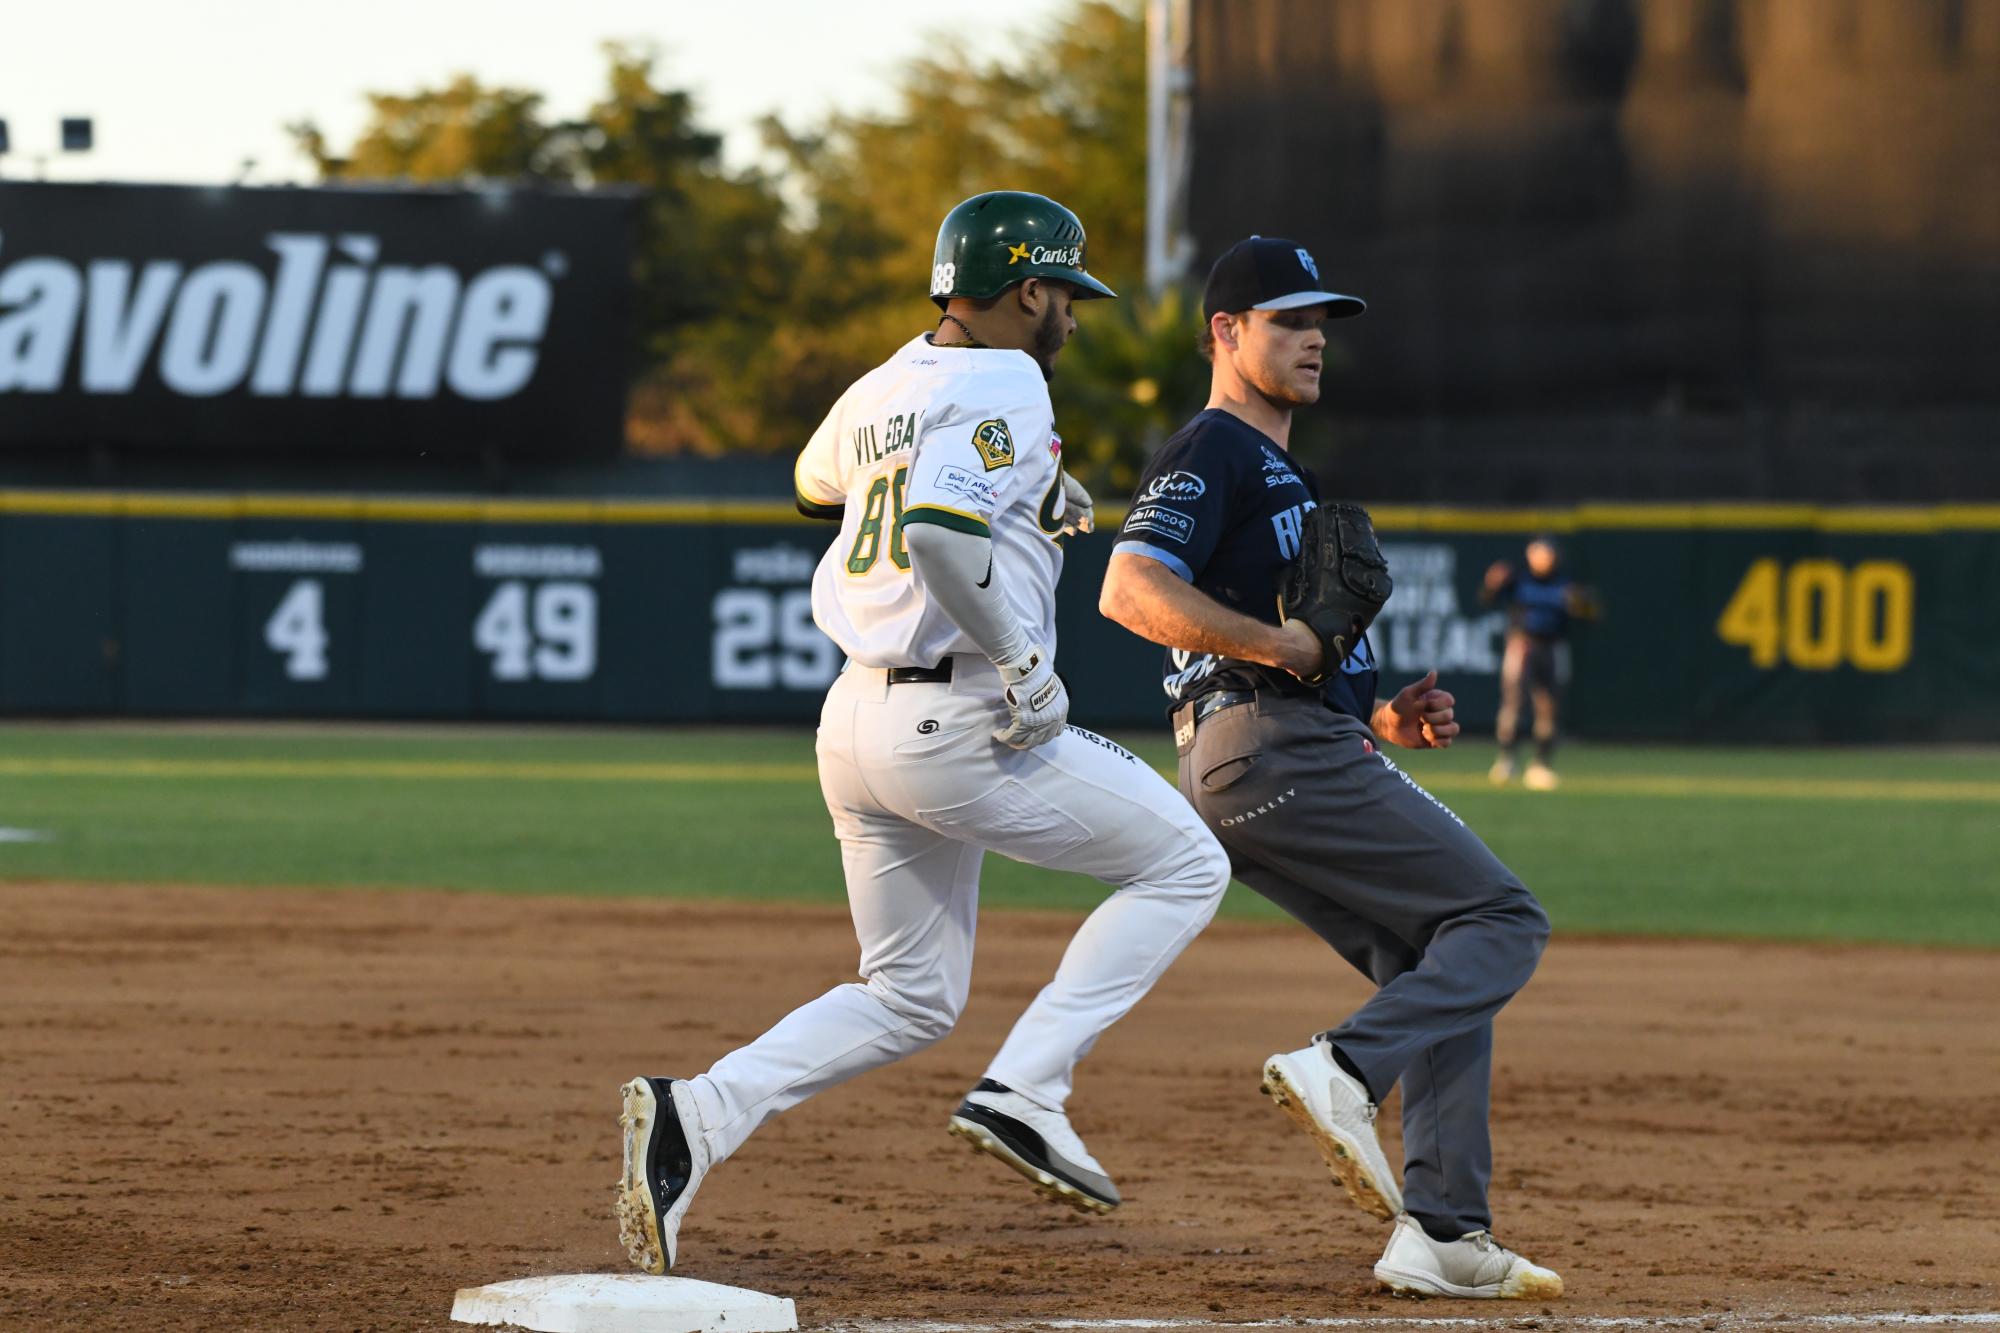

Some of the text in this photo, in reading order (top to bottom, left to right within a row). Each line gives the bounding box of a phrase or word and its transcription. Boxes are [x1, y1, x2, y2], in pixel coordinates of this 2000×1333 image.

[933, 263, 955, 294] 88
[989, 426, 1007, 451] 75
[1147, 509, 1178, 525] ARCO
[264, 579, 329, 680] 4
[474, 581, 599, 680] 49
[712, 588, 840, 689] 25
[1717, 558, 1914, 671] 400
